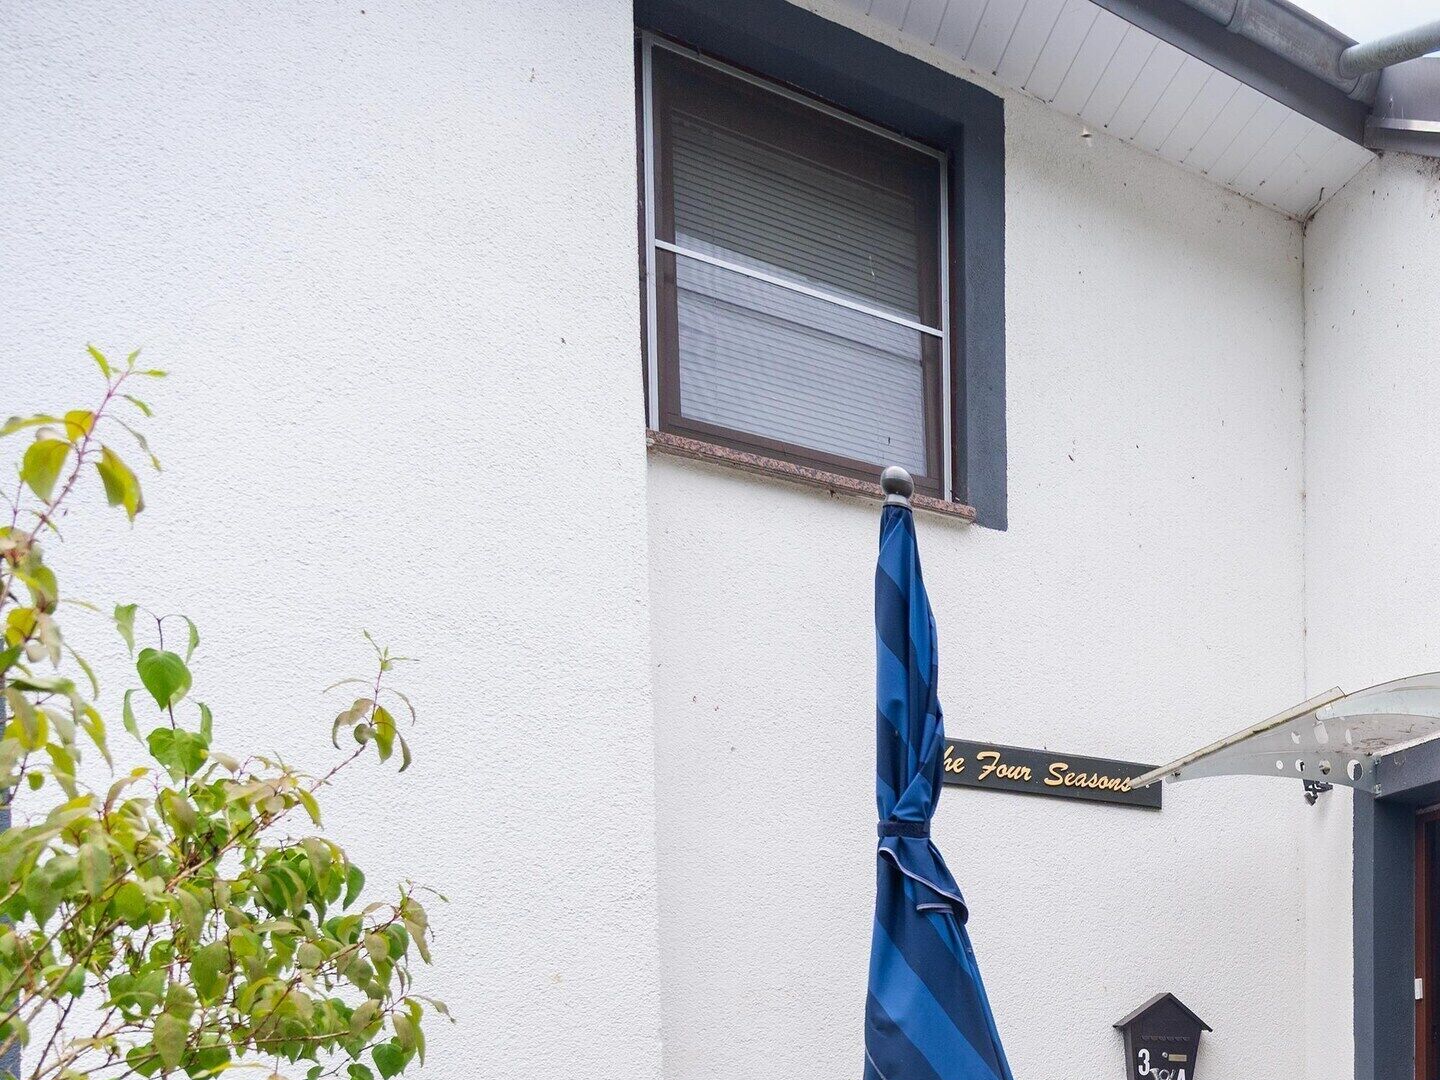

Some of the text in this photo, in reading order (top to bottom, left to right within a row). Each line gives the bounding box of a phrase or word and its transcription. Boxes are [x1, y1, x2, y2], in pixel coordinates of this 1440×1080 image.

[943, 745, 1132, 793] he Four Seasons
[1138, 1048, 1150, 1076] 3
